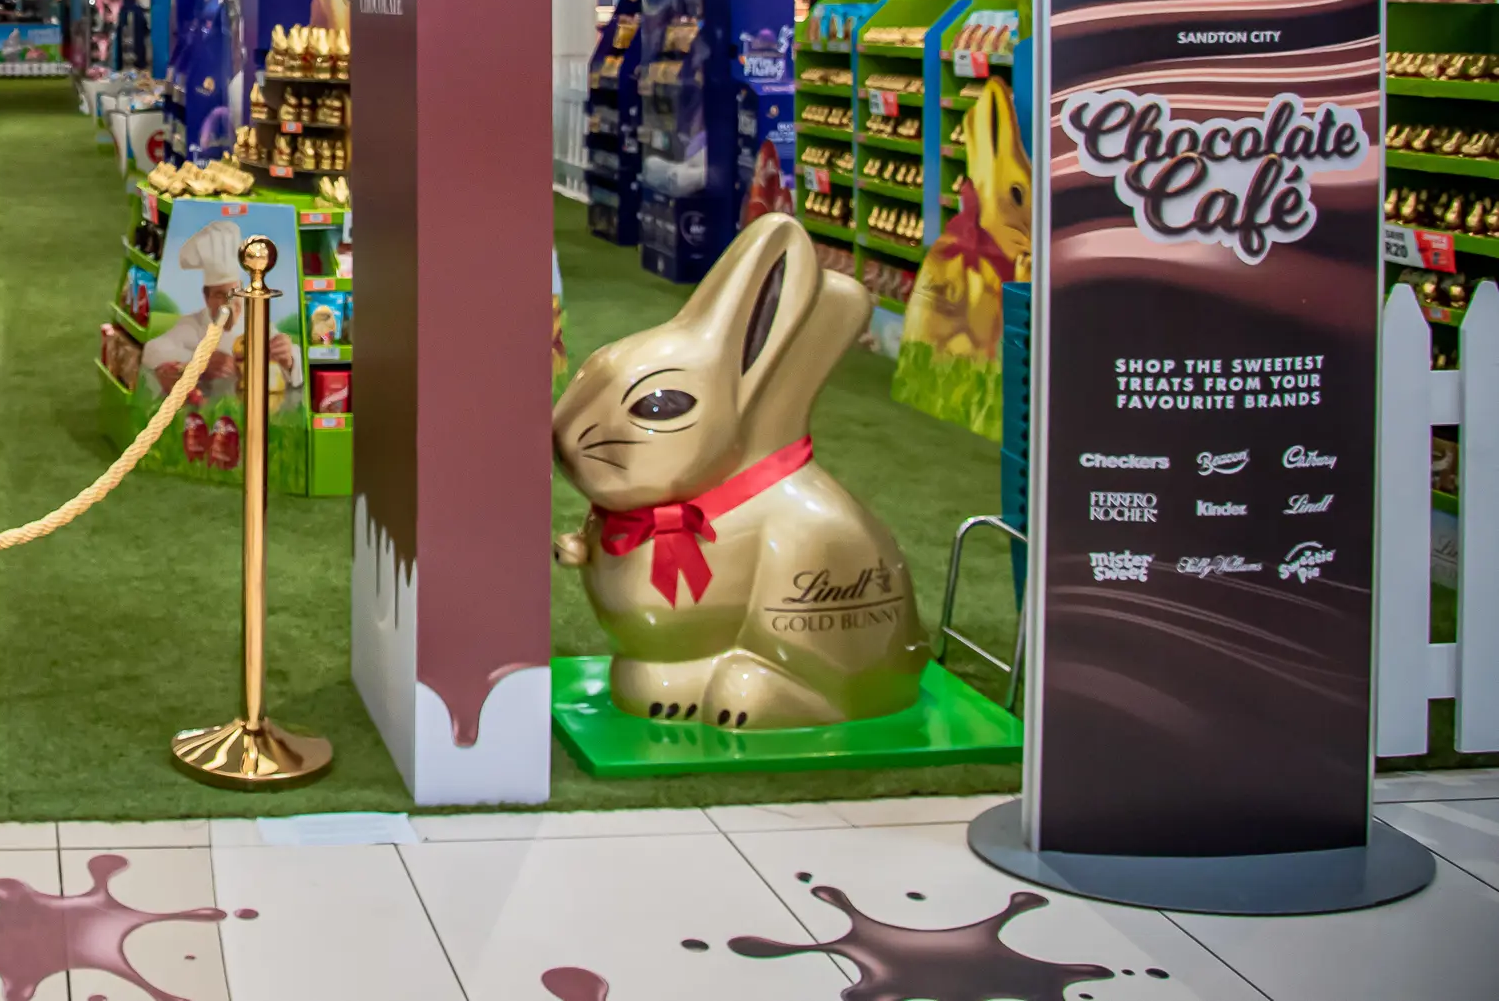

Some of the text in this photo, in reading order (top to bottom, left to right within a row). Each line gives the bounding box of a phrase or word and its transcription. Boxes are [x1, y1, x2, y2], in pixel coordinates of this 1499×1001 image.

[1177, 30, 1282, 44] SANDTON CITY
[1068, 99, 1360, 164] Chocolate
[1124, 152, 1309, 256] Café
[1115, 355, 1325, 374] SHOP THE SWEETEST
[1116, 374, 1321, 392] TREATS FROM YOUR
[1116, 391, 1321, 410] FAVOURITE BRANDS
[1079, 453, 1171, 470] Checkers
[1282, 445, 1337, 469] Cadbury
[1089, 491, 1157, 507] FERRERO
[1196, 499, 1248, 516] Kinder
[1283, 494, 1335, 515] Lindt
[1089, 506, 1158, 523] ROCHER
[782, 568, 873, 604] Lindt
[772, 606, 900, 633] GOLD BUNNY
